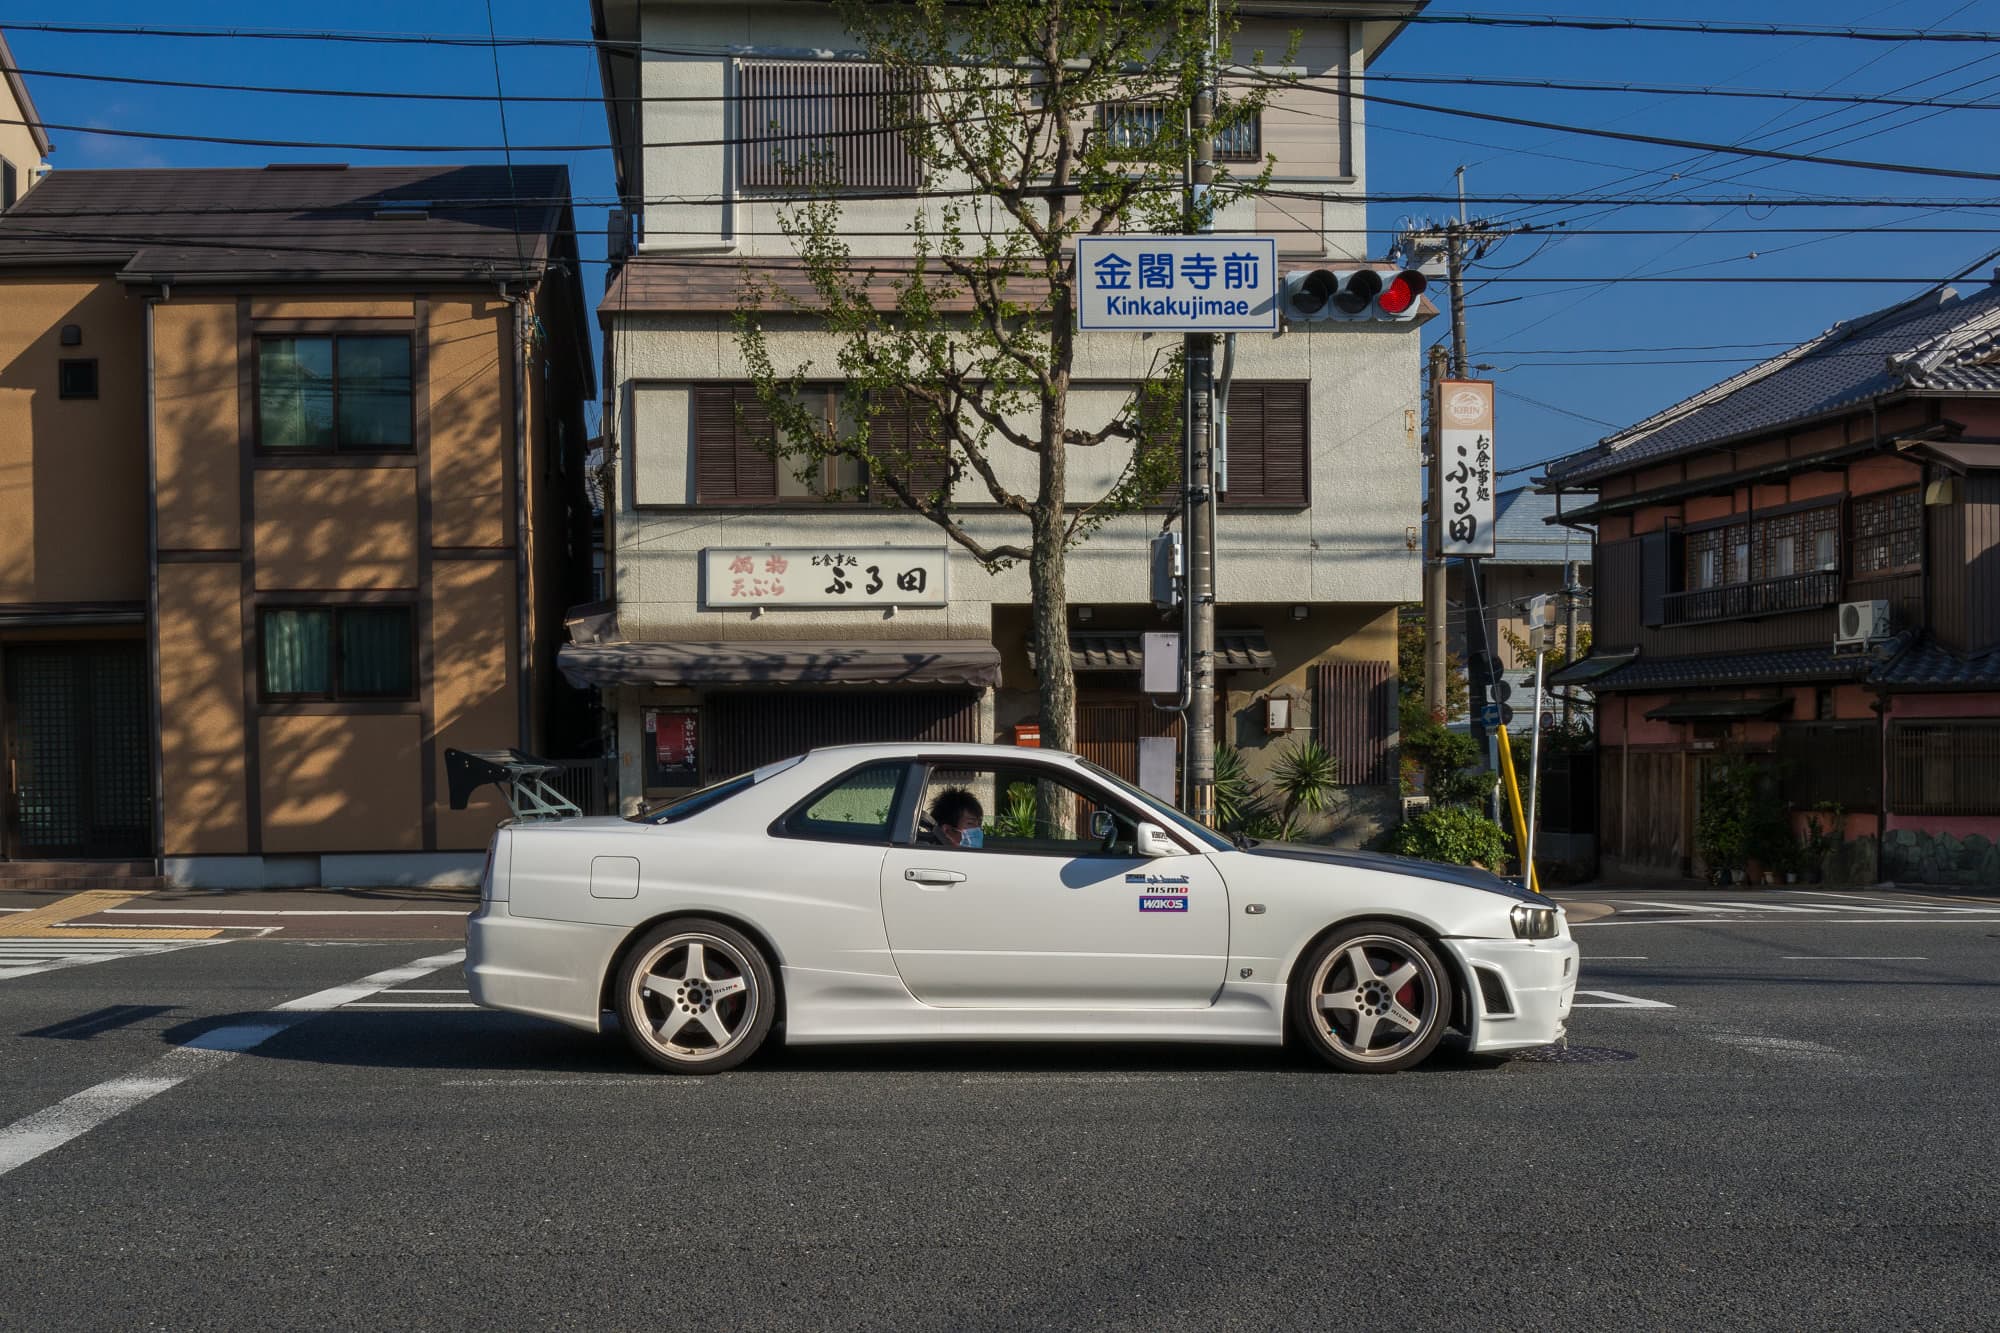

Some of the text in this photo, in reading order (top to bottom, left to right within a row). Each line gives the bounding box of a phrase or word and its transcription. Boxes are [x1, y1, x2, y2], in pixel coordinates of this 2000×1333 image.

[1094, 252, 1260, 290] 金閣寺前
[1107, 295, 1249, 320] Kinkakujimae
[1454, 406, 1480, 415] KIRIN
[1476, 434, 1490, 502] お食事処
[1445, 445, 1477, 544] ふる田
[811, 552, 859, 567] お食事処
[730, 578, 785, 598] 天ぶら
[825, 566, 927, 595] ふる田
[1146, 886, 1189, 894] nismo
